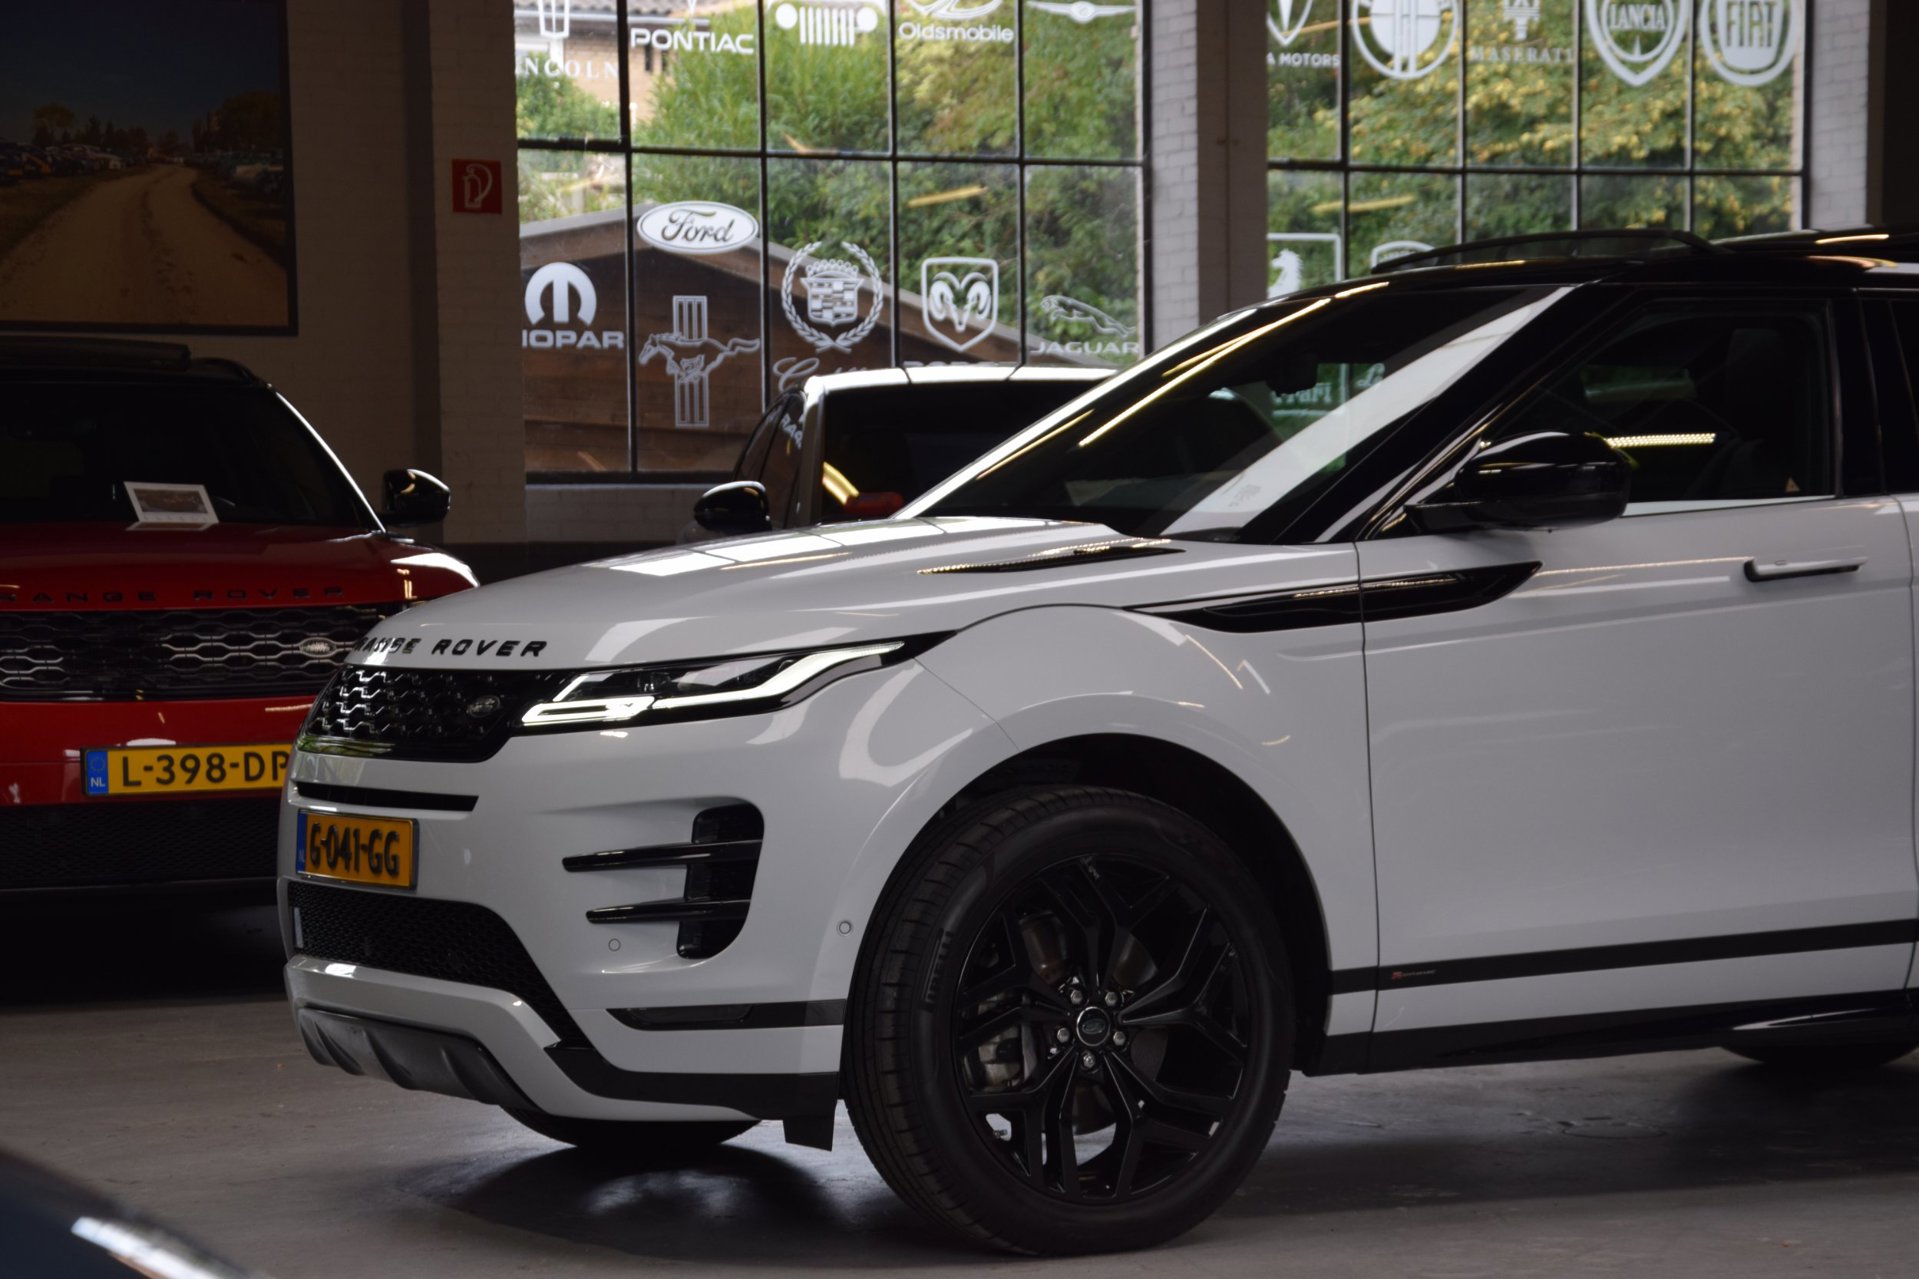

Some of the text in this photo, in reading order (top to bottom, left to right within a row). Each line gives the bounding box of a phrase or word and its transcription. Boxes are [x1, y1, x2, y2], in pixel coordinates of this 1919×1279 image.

[1609, 4, 1668, 32] LANCIA
[1726, 0, 1778, 47] FIAT
[630, 28, 754, 54] PONTIAC
[899, 22, 1014, 43] Oldsmobile
[1279, 52, 1341, 67] MOTORS
[661, 208, 736, 243] Ford
[522, 329, 625, 349] OPAR
[1030, 341, 1140, 354] JAGUAR
[0, 587, 346, 602] RANGE ROVER
[354, 637, 548, 657] RANGE ROVER
[90, 776, 106, 788] NL
[310, 822, 400, 877] G-041-GG
